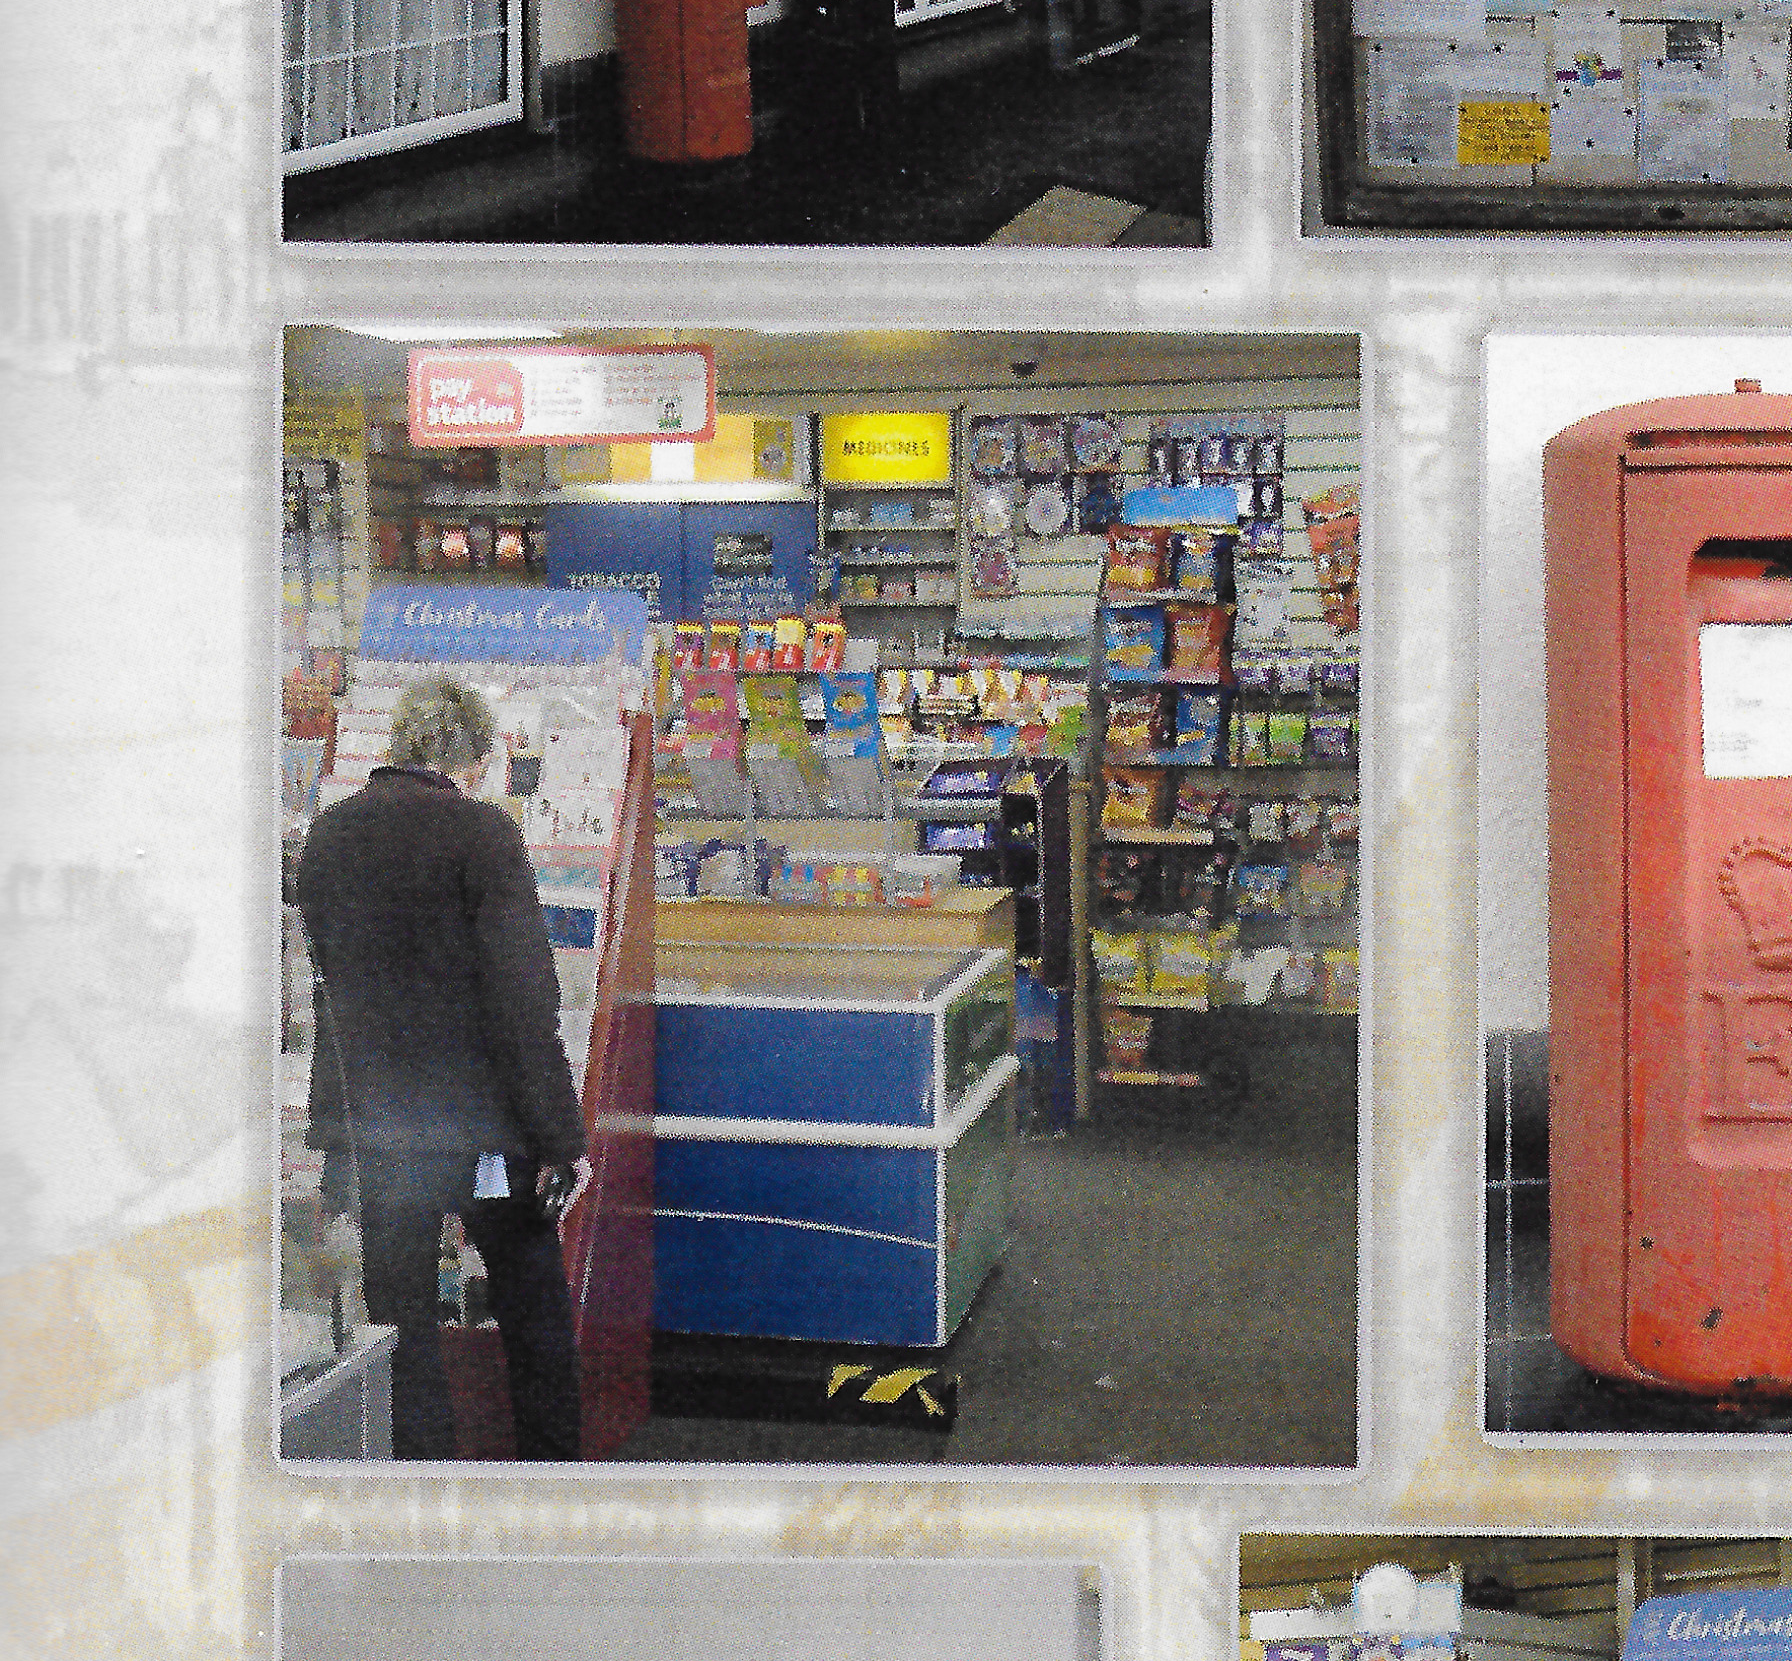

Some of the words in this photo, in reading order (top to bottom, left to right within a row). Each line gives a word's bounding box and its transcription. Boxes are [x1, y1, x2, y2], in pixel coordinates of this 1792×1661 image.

[426, 396, 516, 425] station
[843, 440, 930, 456] MEDICINES
[404, 600, 525, 630] Christmas
[535, 598, 605, 632] Cards
